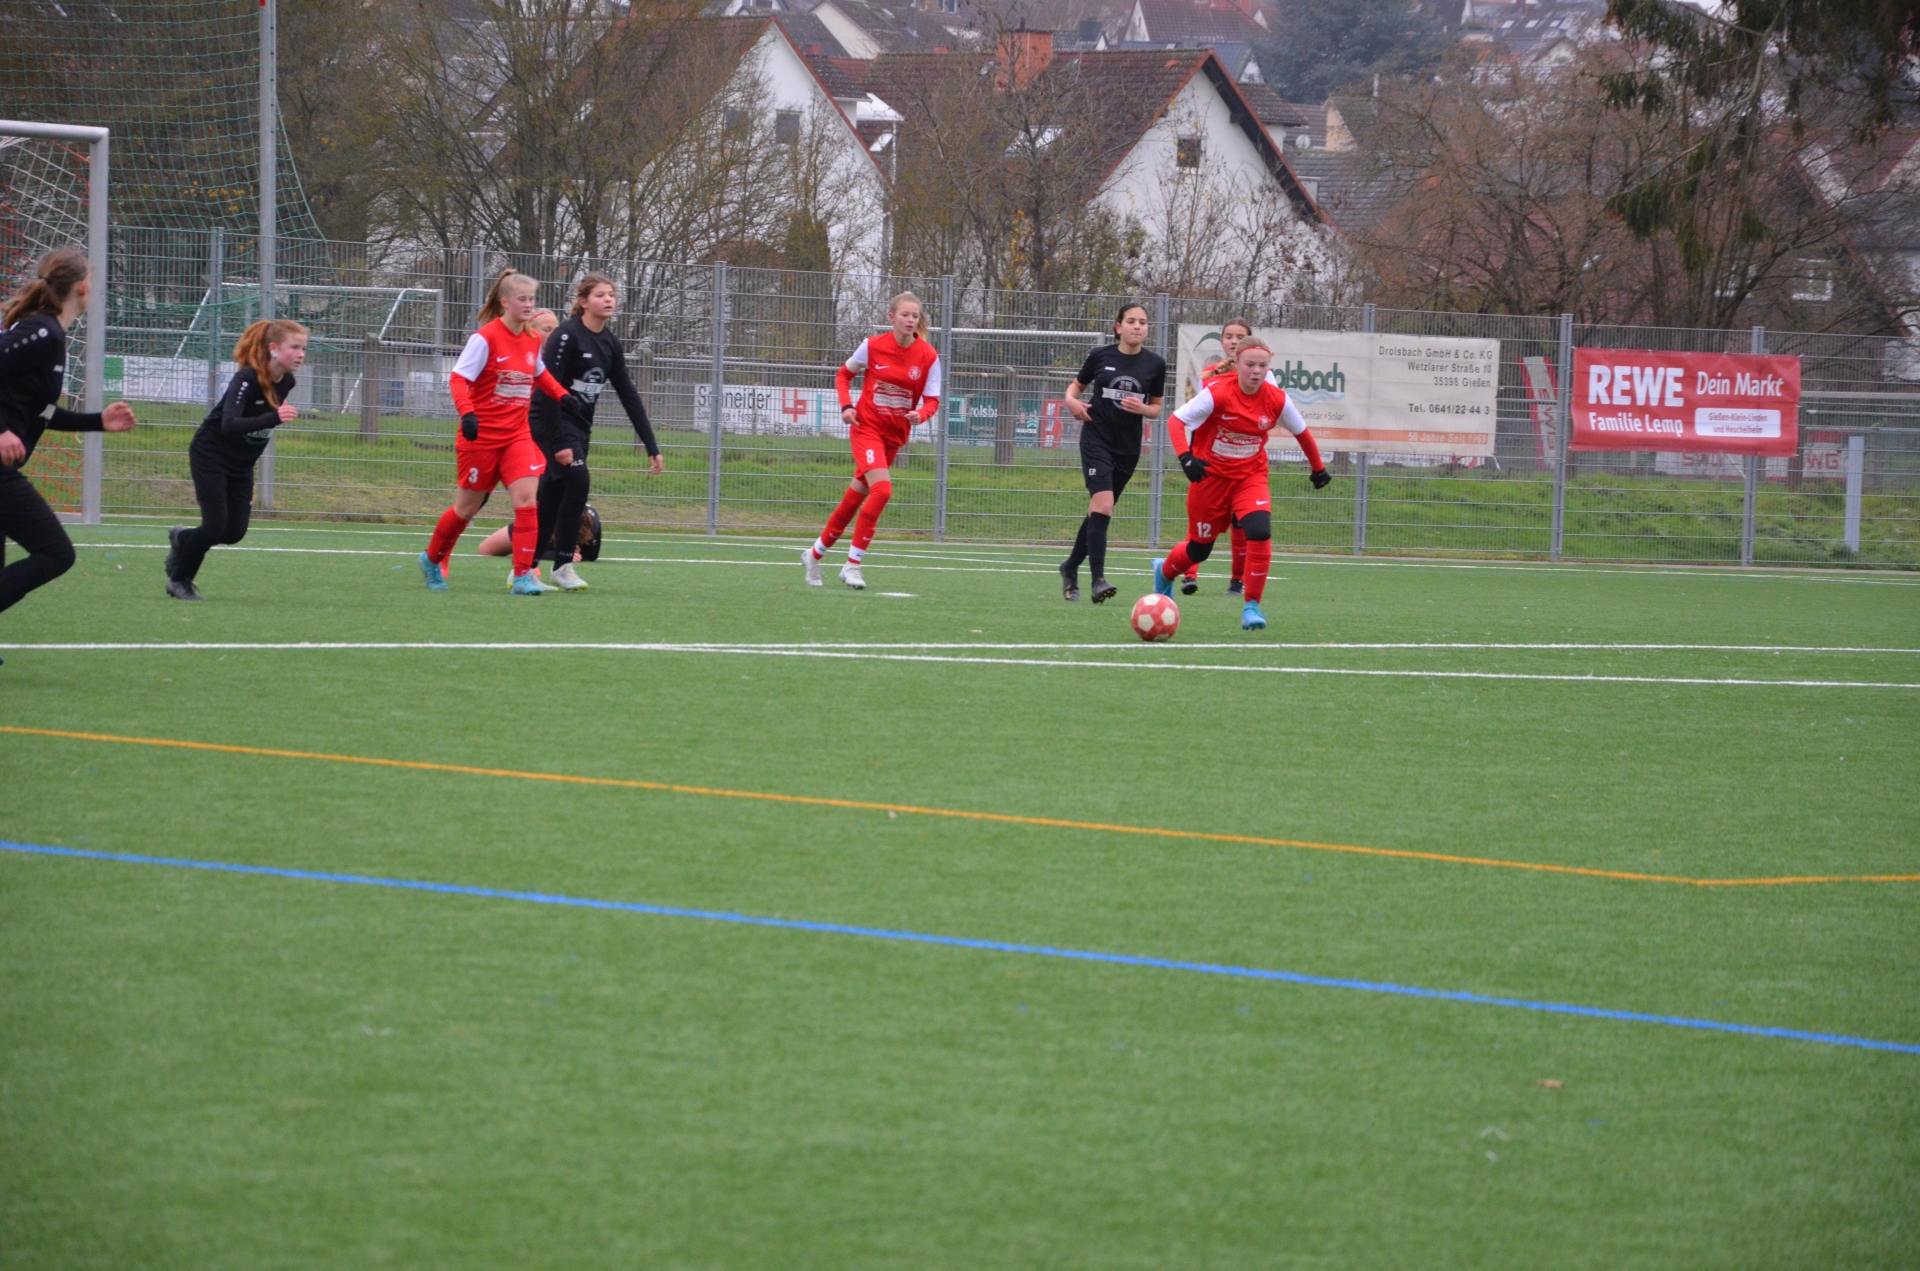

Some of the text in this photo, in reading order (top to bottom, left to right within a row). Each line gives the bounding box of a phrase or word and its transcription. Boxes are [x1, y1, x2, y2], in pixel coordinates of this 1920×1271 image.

[1379, 346, 1493, 360] Drolsbach GmbH & Co. KG
[1408, 361, 1491, 374] Wetzlarer Straße 10
[1434, 377, 1491, 388] 35398 Gießen
[1588, 364, 1685, 407] REWE
[1696, 371, 1784, 397] Dein Markt
[698, 386, 771, 409] Scneider
[1408, 403, 1490, 415] Tel. 0641/22 44 3
[1327, 412, 1345, 421] Solar
[1708, 412, 1768, 422] Gießen-Klein-Linden
[1588, 412, 1684, 437] Familie Lemp
[1713, 425, 1763, 434] und Heuchelheim
[1408, 432, 1487, 444] 50 Jahre Seit 1969
[866, 449, 875, 464] 8
[468, 467, 479, 484] 3
[1197, 522, 1212, 538] 12
